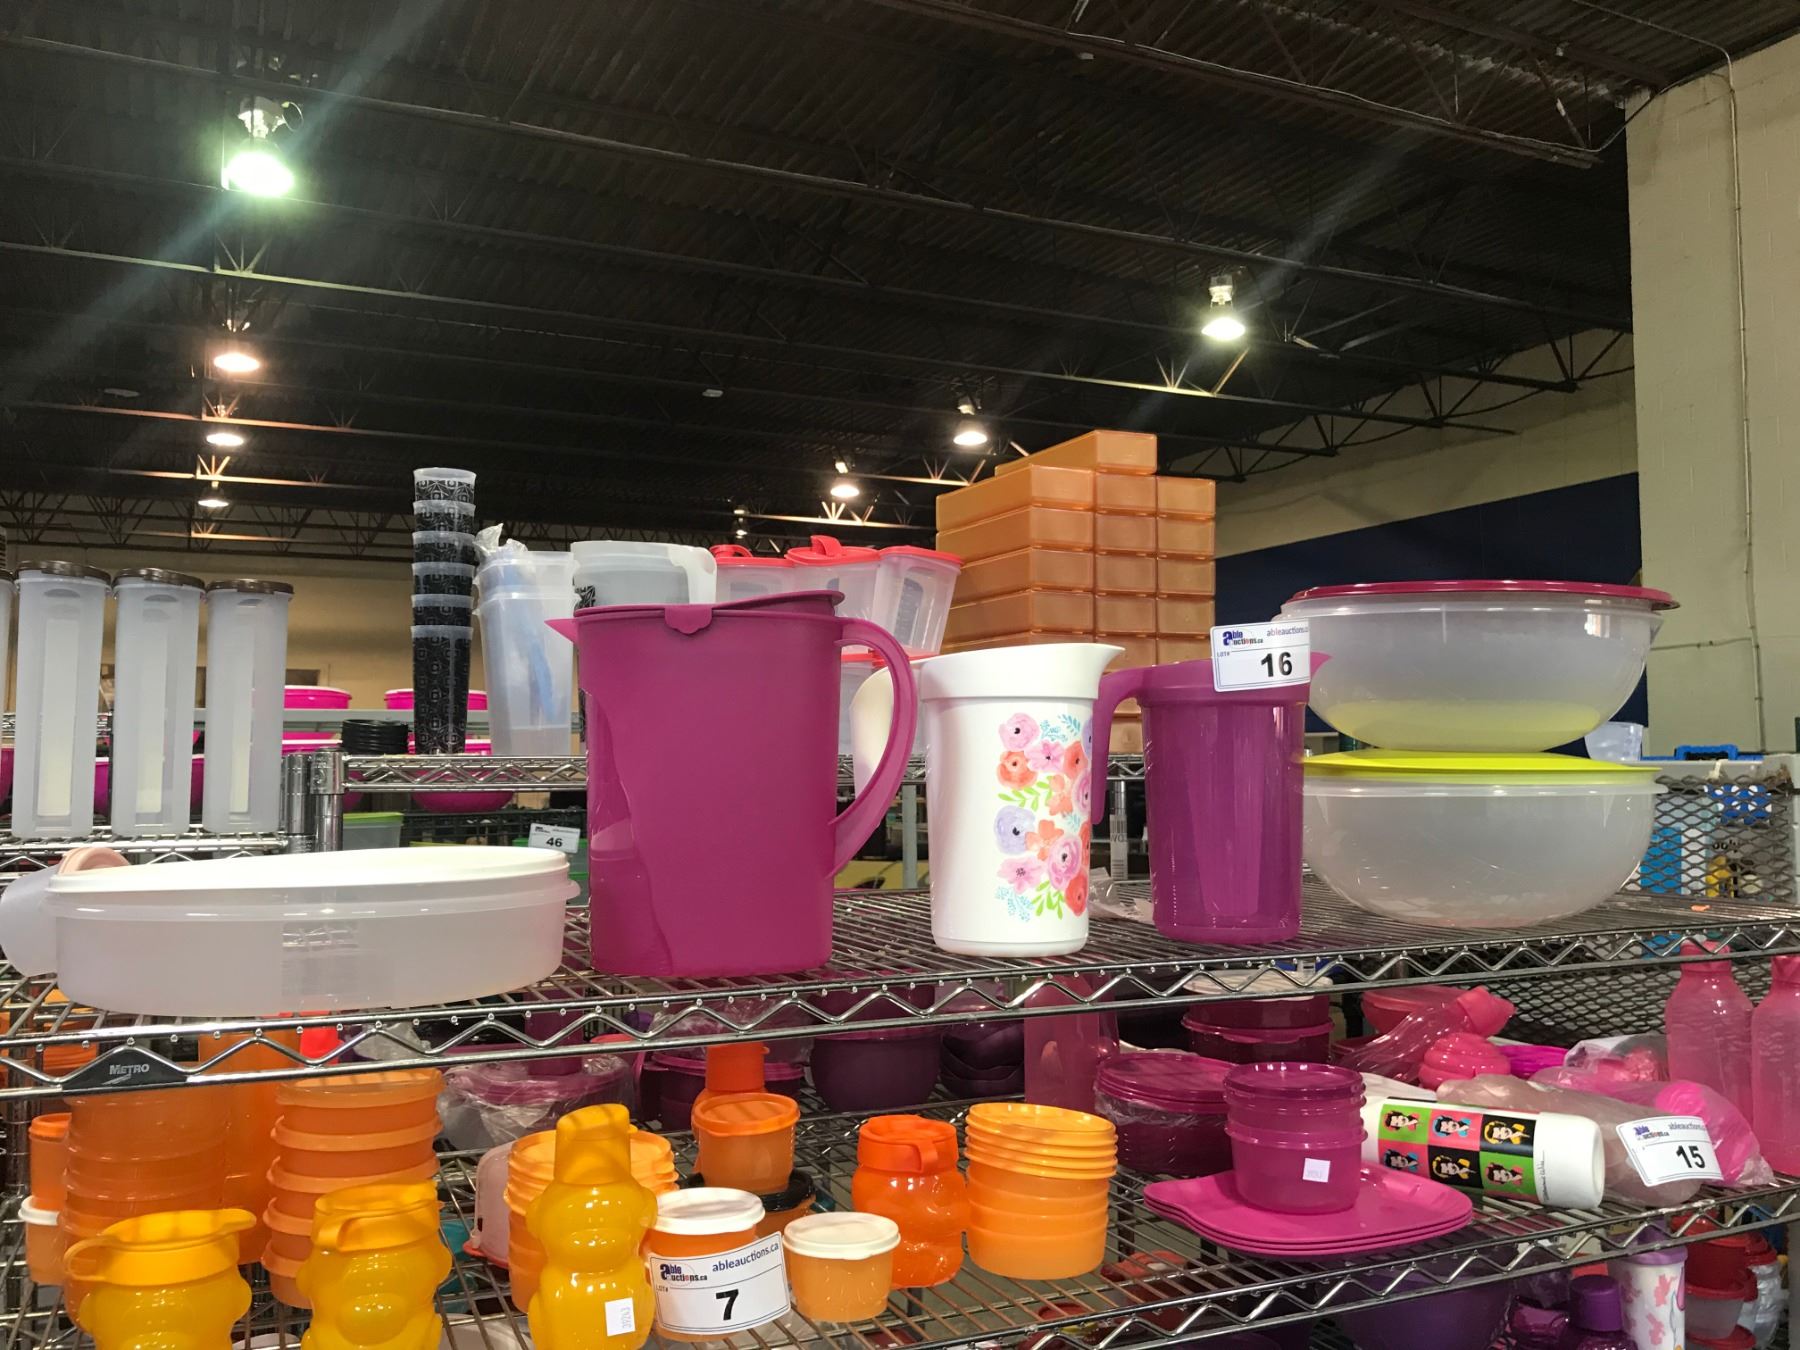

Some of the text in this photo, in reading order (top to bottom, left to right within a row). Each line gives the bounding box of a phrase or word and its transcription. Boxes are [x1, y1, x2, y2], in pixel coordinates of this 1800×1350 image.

[1261, 651, 1293, 677] 16
[546, 837, 563, 847] 46
[109, 1063, 150, 1077] METRO
[1676, 1145, 1706, 1168] 15
[712, 1242, 779, 1272] ableauctions.ca
[715, 1288, 739, 1321] 7
